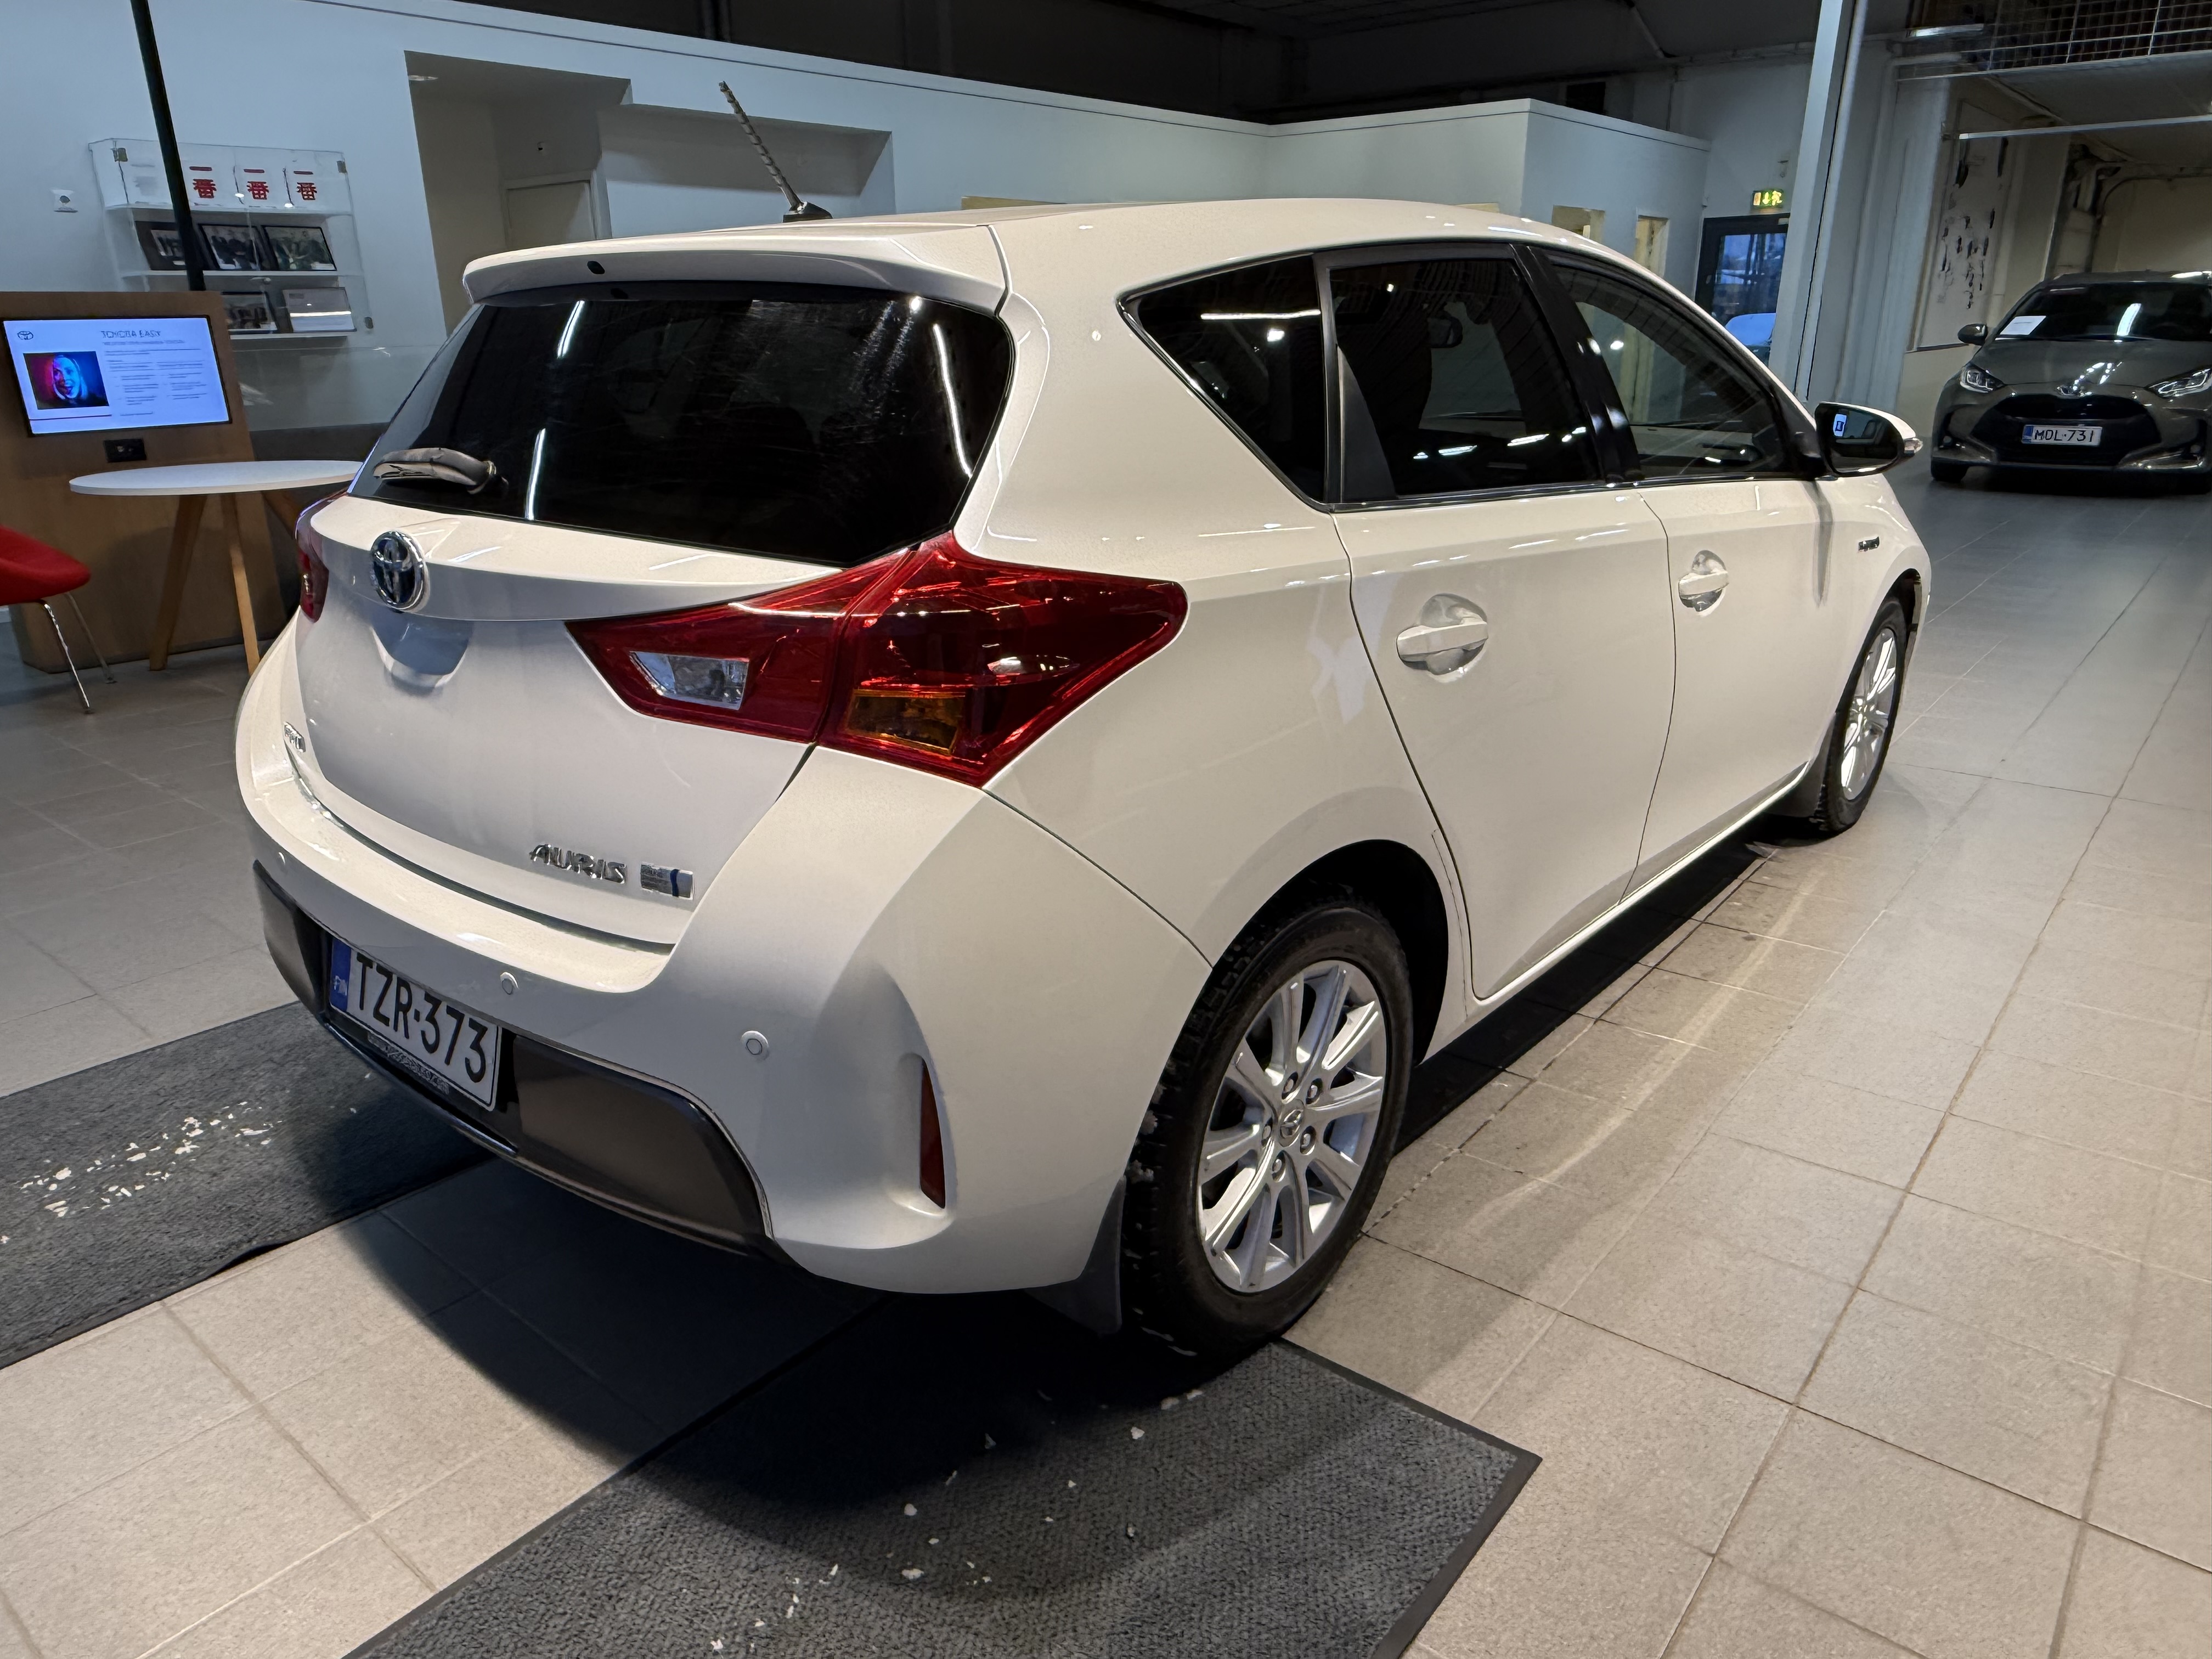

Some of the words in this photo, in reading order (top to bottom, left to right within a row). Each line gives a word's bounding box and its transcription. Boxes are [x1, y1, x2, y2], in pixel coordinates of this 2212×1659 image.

[101, 330, 137, 338] TOYOTA
[2034, 429, 2094, 443] MOL-731
[528, 844, 627, 884] AURIS
[356, 952, 488, 1083] TZR-373
